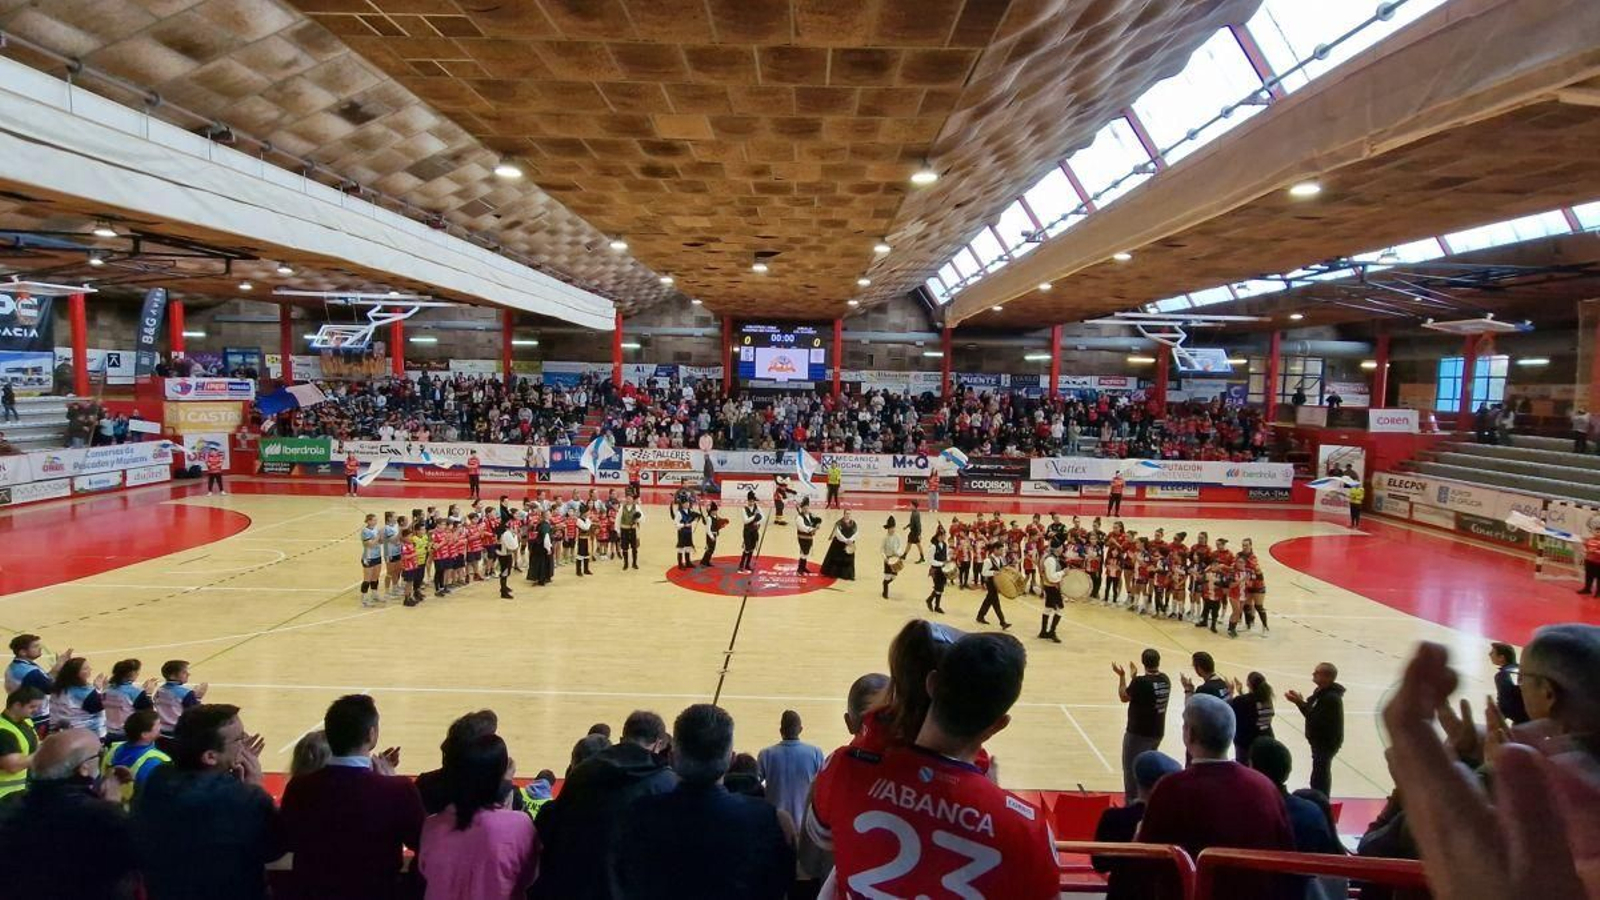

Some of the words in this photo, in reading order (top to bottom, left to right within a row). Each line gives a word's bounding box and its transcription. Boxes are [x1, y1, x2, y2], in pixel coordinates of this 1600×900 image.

[0, 327, 39, 338] ACIA
[744, 336, 751, 345] 0
[770, 334, 795, 343] 00:00
[813, 338, 821, 348] 0
[960, 375, 998, 385] PUENTE
[282, 446, 325, 456] Iberdrola
[892, 456, 929, 469] M+Q
[599, 472, 620, 480] M+Q
[847, 810, 1002, 900] 23
